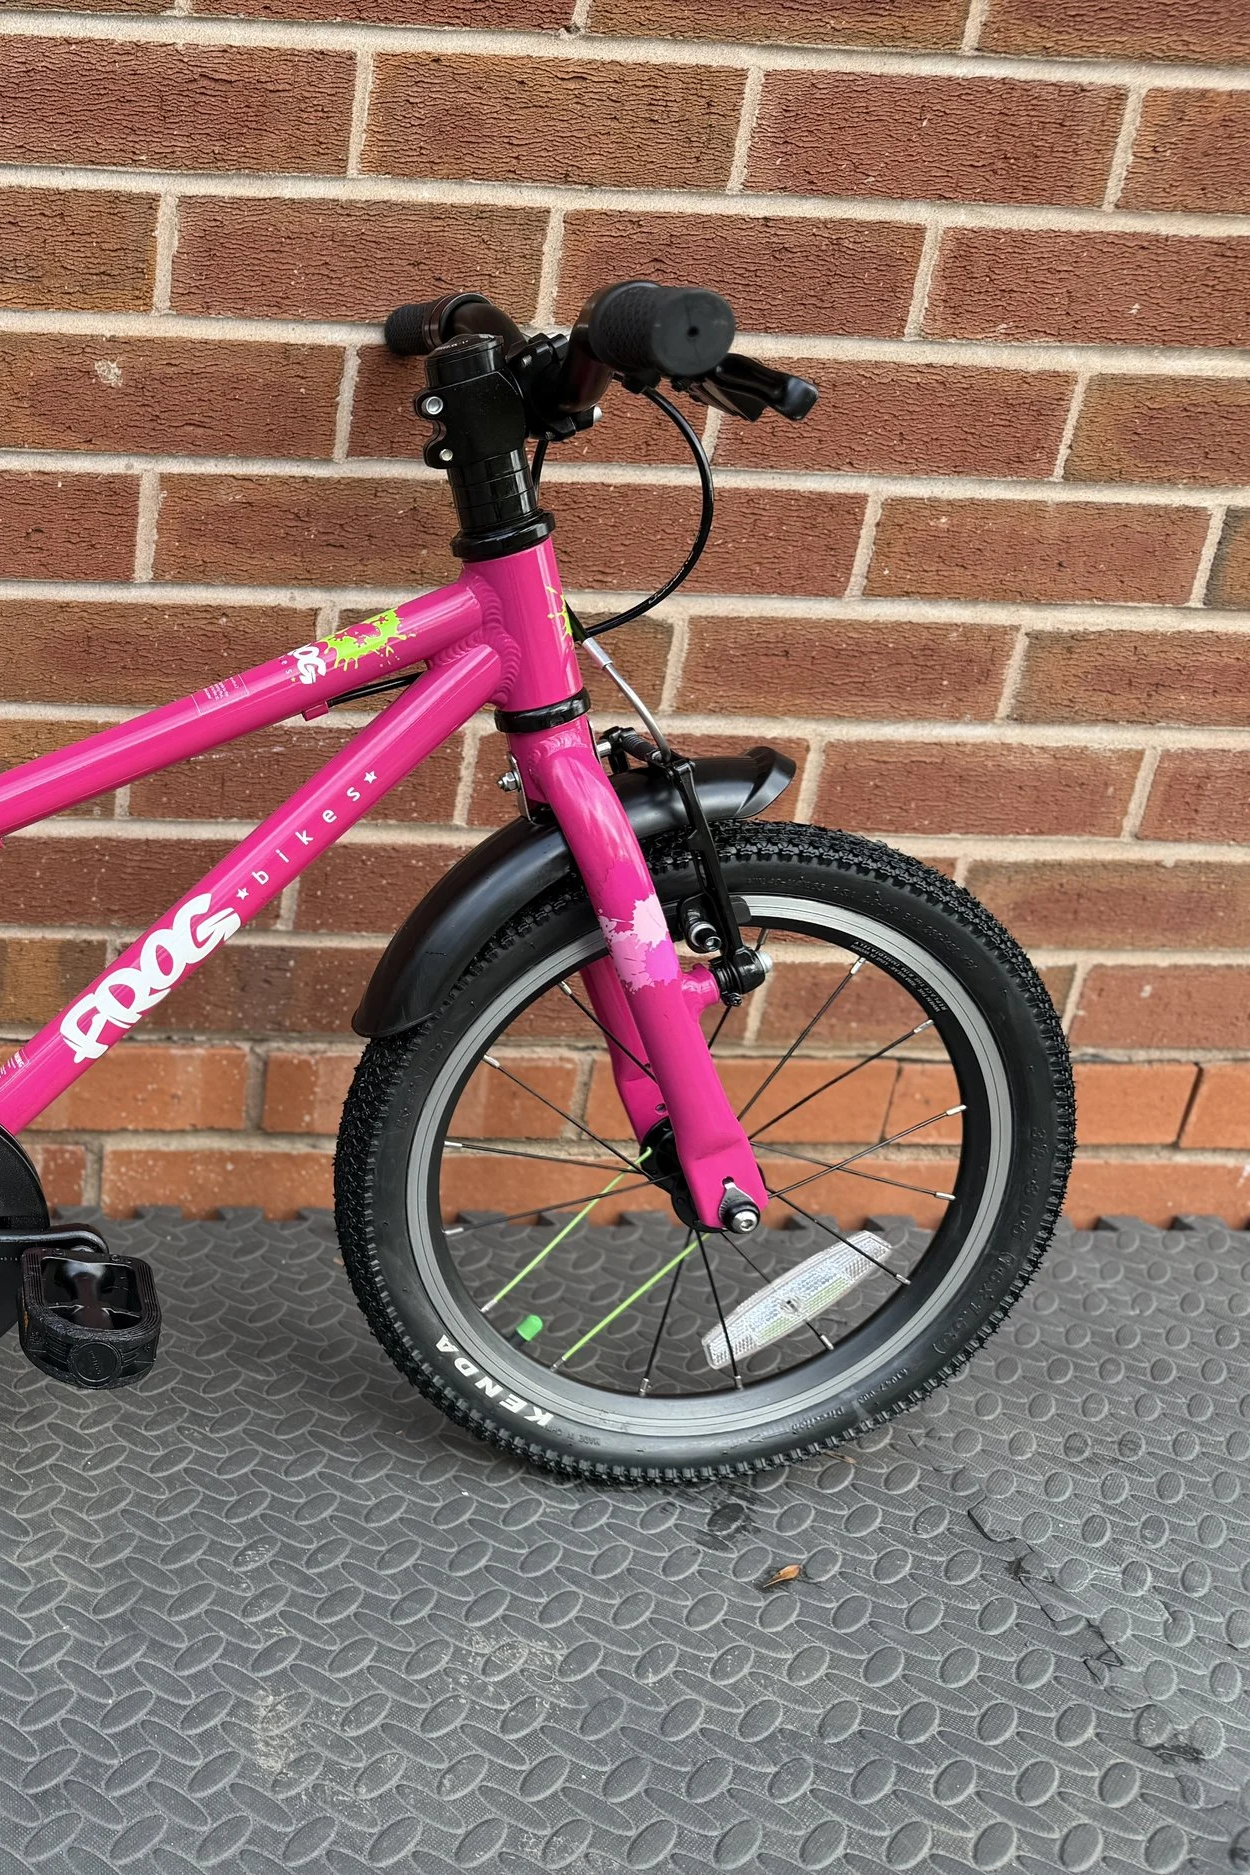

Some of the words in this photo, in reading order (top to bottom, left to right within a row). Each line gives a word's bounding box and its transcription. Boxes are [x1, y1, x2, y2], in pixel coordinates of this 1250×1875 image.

[251, 786, 361, 885] bikes
[59, 892, 242, 1064] FROG
[923, 986, 947, 1011] REPLACE
[435, 1333, 555, 1427] KENDA
